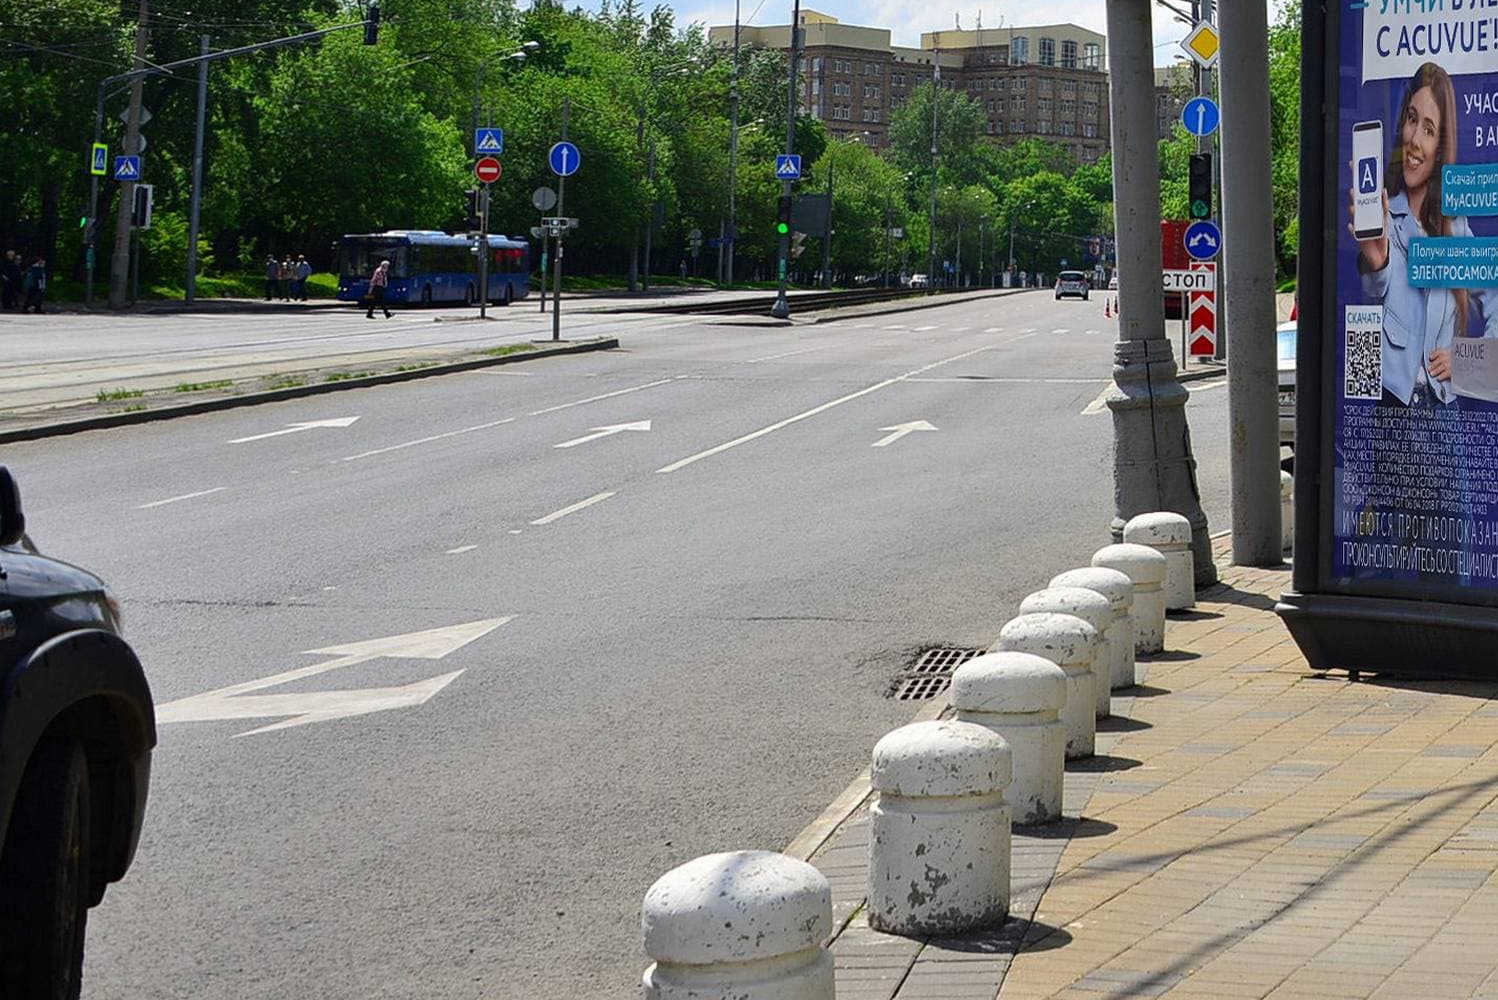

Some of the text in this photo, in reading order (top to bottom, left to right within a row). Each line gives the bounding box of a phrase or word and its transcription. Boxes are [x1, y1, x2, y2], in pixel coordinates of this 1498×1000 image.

[1475, 128, 1484, 147] В
[1445, 169, 1476, 185] Скачай
[1445, 191, 1498, 211] MyACUVUE
[1412, 242, 1446, 259] Получи
[1447, 246, 1470, 258] шанс
[1162, 273, 1206, 288] СТОП
[1347, 311, 1382, 325] СКАЧАТЬ
[1455, 342, 1486, 360] ACUVUE
[1342, 510, 1393, 536] ИМЕЮТСЯ
[1342, 541, 1435, 573] ПРОКОНСУЛЬТИРУЙТЕСЬ
